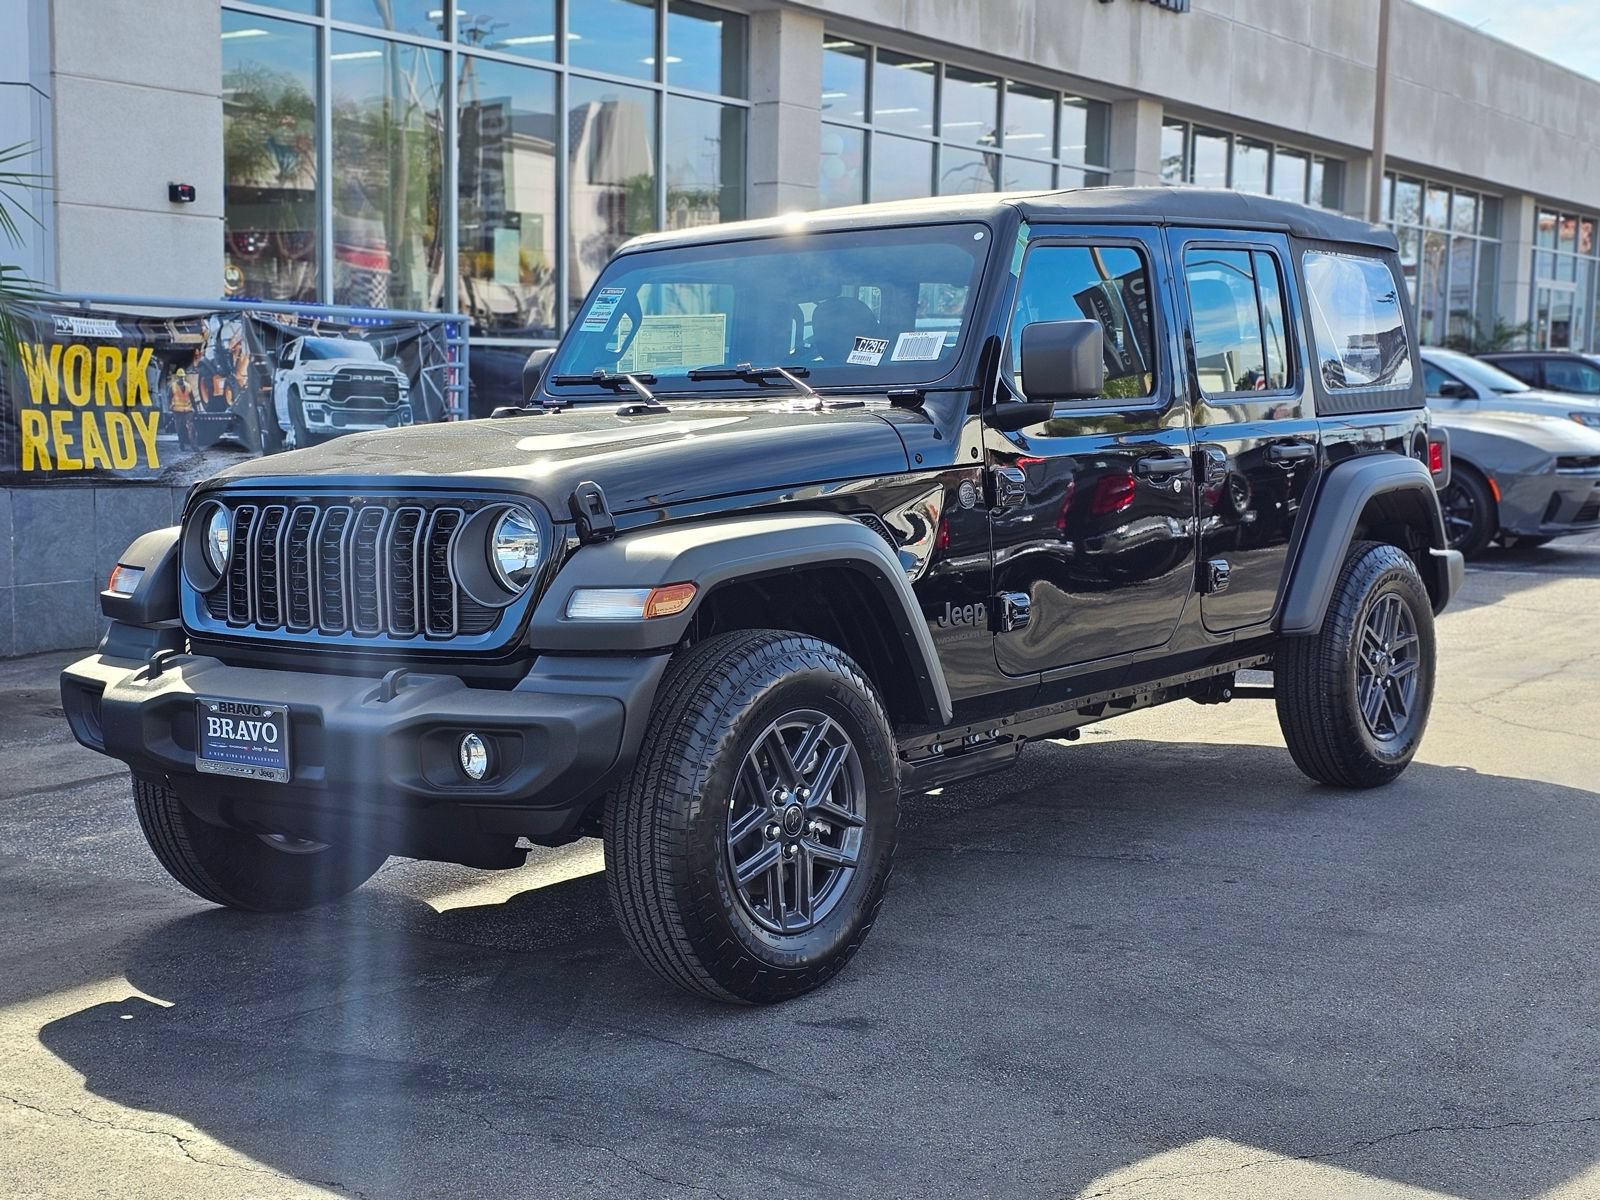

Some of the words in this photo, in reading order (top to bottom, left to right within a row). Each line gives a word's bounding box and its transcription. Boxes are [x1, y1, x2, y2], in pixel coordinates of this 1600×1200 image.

[18, 342, 154, 407] WORK
[21, 409, 160, 471] READY
[937, 602, 986, 628] Jeep
[219, 702, 261, 717] BRAVO
[206, 716, 278, 743] BRAVO
[259, 768, 275, 779] Jeep
